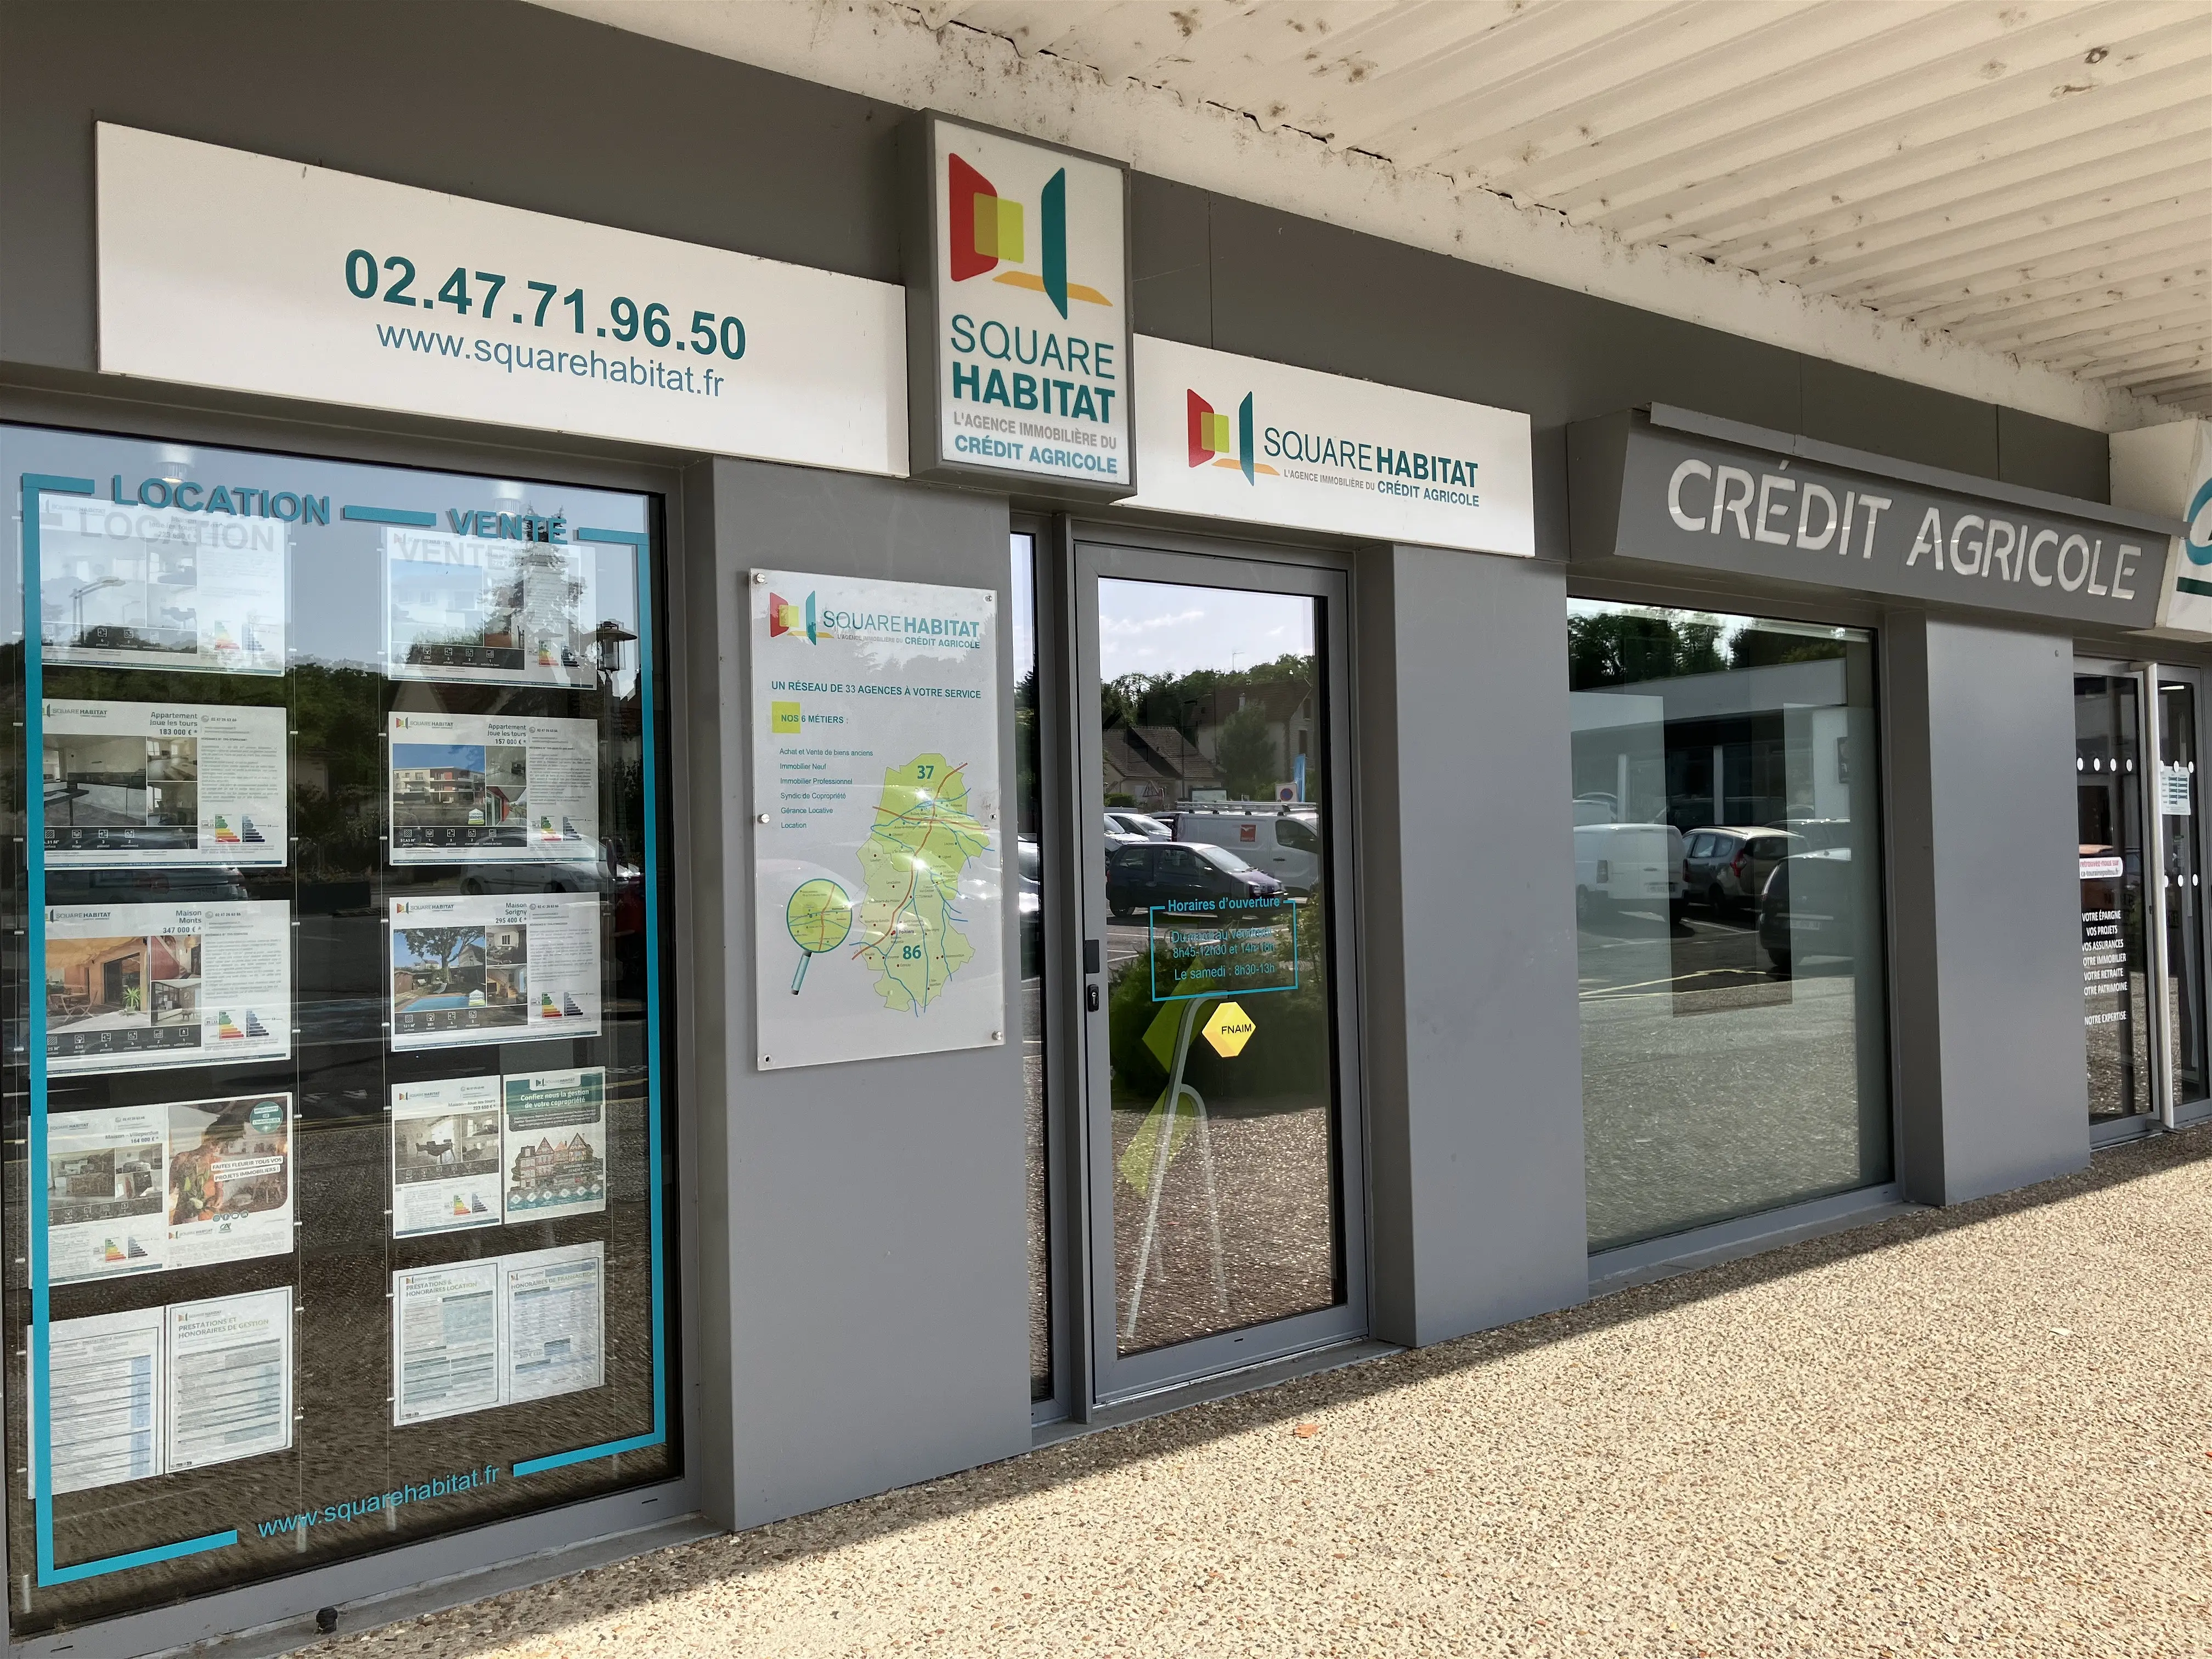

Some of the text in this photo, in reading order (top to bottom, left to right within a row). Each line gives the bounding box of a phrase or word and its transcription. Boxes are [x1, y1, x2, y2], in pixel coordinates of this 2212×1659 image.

[345, 249, 746, 360] 02.47.71.96.50
[951, 314, 1115, 380] SQUARE
[376, 324, 724, 397] www.squarehabitat.fr
[953, 361, 1115, 424] HABITAT
[953, 412, 1116, 449] L'AGENCE IMMOBILIÈRE DU
[955, 435, 1117, 474] CRÉDIT AGRICOLE
[1284, 469, 1479, 507] L'AGENCE IMMOBILIÈRE DU CRÉDIT AGRICOLE
[113, 474, 330, 525] LOCATION
[449, 508, 568, 545] VENTE
[1667, 458, 2142, 600] CRÉDIT AGRICOLE
[905, 636, 935, 647] CRÉDIT
[938, 639, 980, 649] AGRICOLE
[771, 680, 981, 699] UN RÉSEAU DE 33 AGENCES À VOTRE SERVICE
[808, 714, 844, 724] MÉTIERS
[917, 765, 934, 779] 37
[1168, 896, 1280, 912] Horaires d'ouverture
[2082, 910, 2121, 922] VOTRE ÉPARGNE
[1172, 931, 1186, 943] Du
[2086, 925, 2118, 936] VOS PROJETS
[902, 945, 921, 960] 86
[1173, 944, 1226, 958] 8h45-12h30
[1229, 945, 1237, 954] et
[2082, 939, 2123, 952] VOS ASSURANCES
[2083, 953, 2126, 966] OTRE IMMOBILIER
[1175, 969, 1187, 980] Le
[1190, 966, 1226, 979] samedi
[1235, 963, 1275, 975] 8h30-13h
[2084, 968, 2124, 981] VOTRE RETRAITE
[2084, 981, 2127, 996] OTRE PATRIMOINE
[2085, 1011, 2126, 1026] NOTRE EXPERTISE
[1221, 1024, 1252, 1035] FNAIM
[551, 1097, 585, 1106] copropriété
[240, 1167, 276, 1176] IMMOBILIERS
[406, 1280, 447, 1290] PRESTATIONS
[406, 1282, 477, 1296] HONORAIRES LOCATION
[511, 1279, 548, 1289] HONORAIRES
[179, 1318, 227, 1331] PRESTATIONS
[179, 1326, 226, 1339] HONORAIRES
[239, 1319, 269, 1329] GESTION
[258, 1464, 500, 1537] www.squarehabitat.fr
